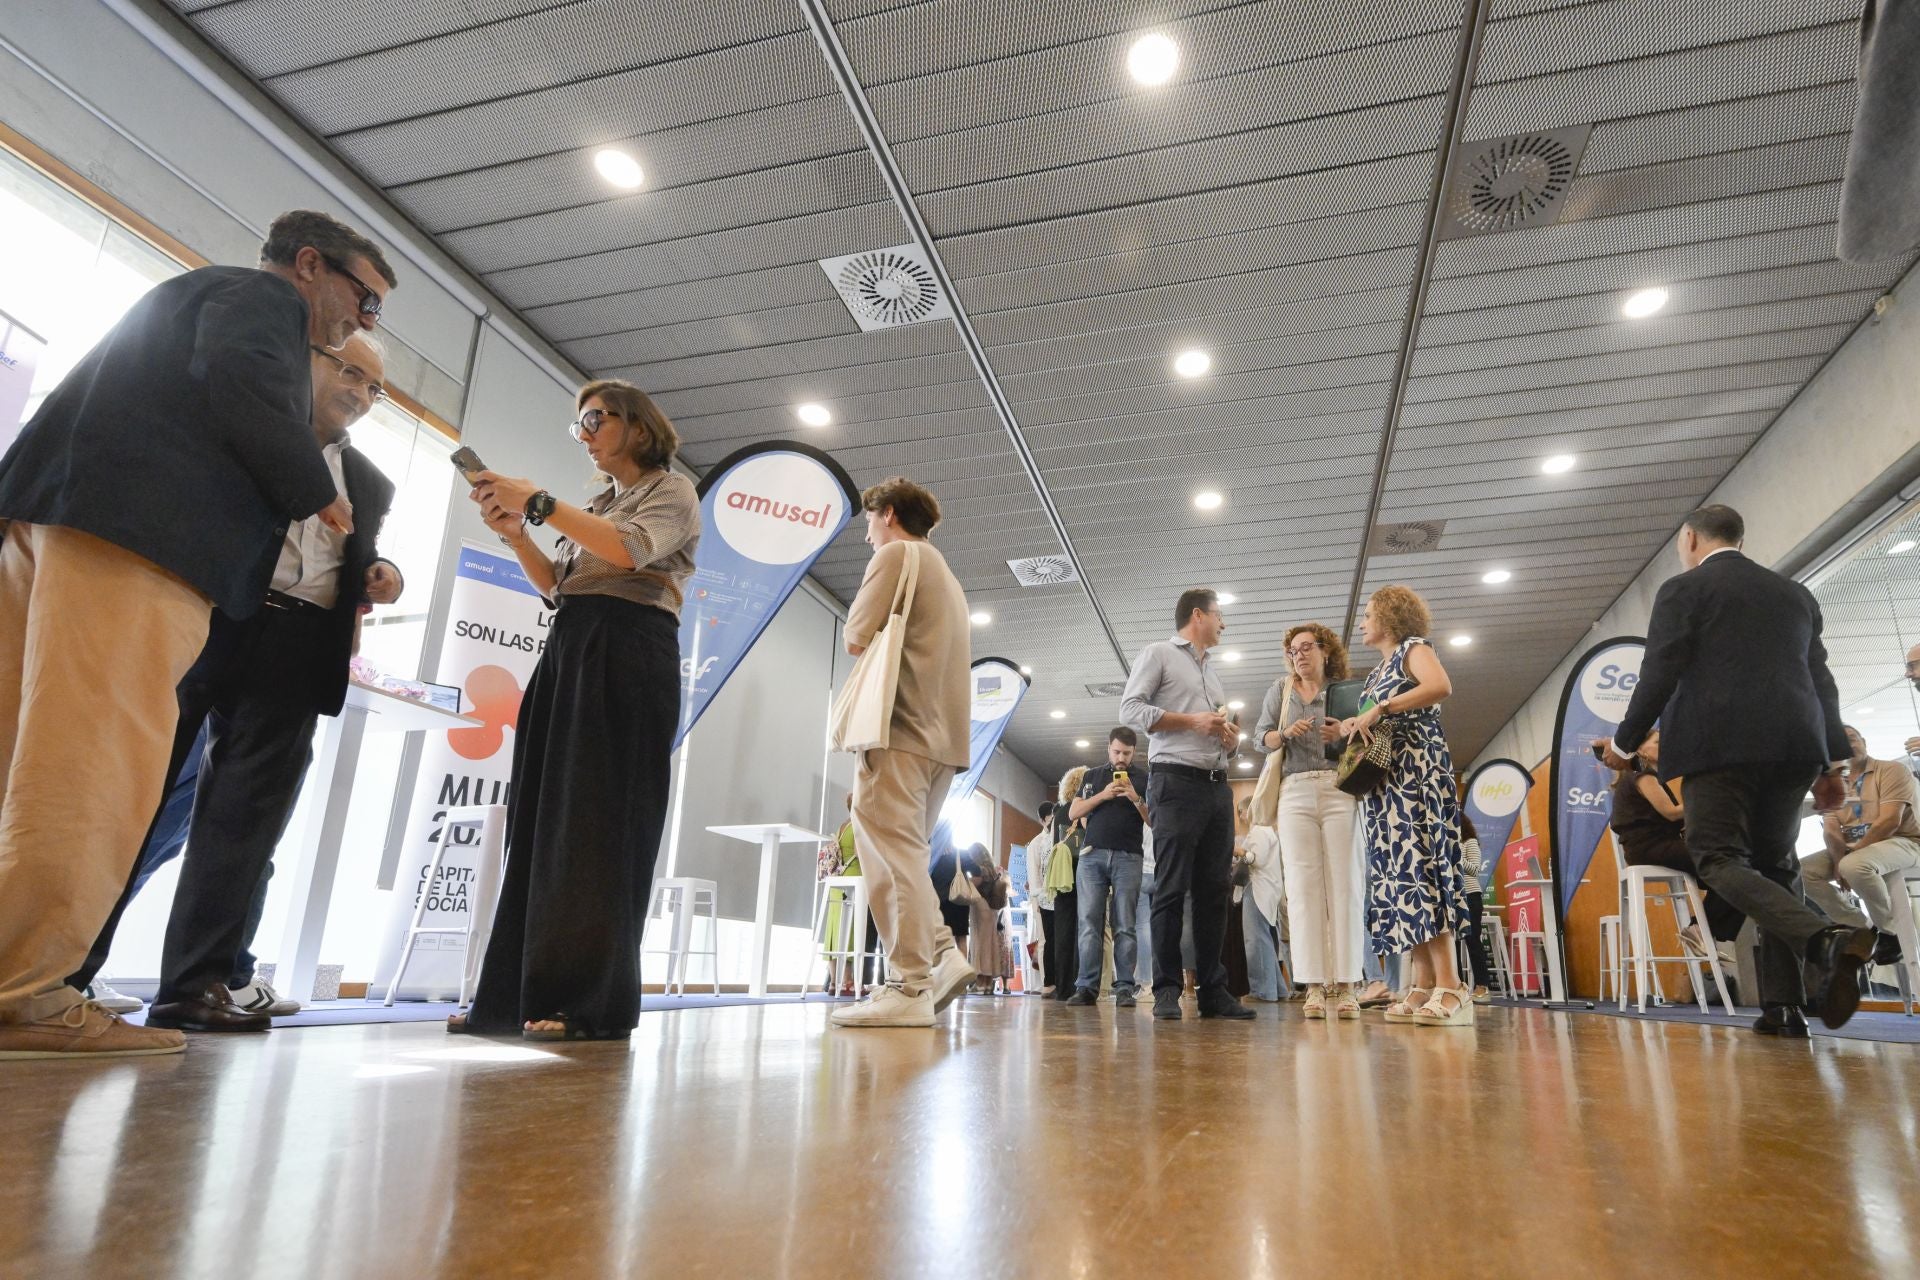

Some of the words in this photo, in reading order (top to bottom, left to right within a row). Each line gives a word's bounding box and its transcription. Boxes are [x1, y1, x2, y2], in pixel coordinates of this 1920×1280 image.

[727, 492, 832, 529] amusal
[464, 560, 494, 574] amusal
[455, 620, 497, 643] SON
[499, 630, 535, 653] LAS
[1480, 781, 1513, 800] info
[1566, 787, 1608, 806] Sef
[446, 882, 467, 897] LA
